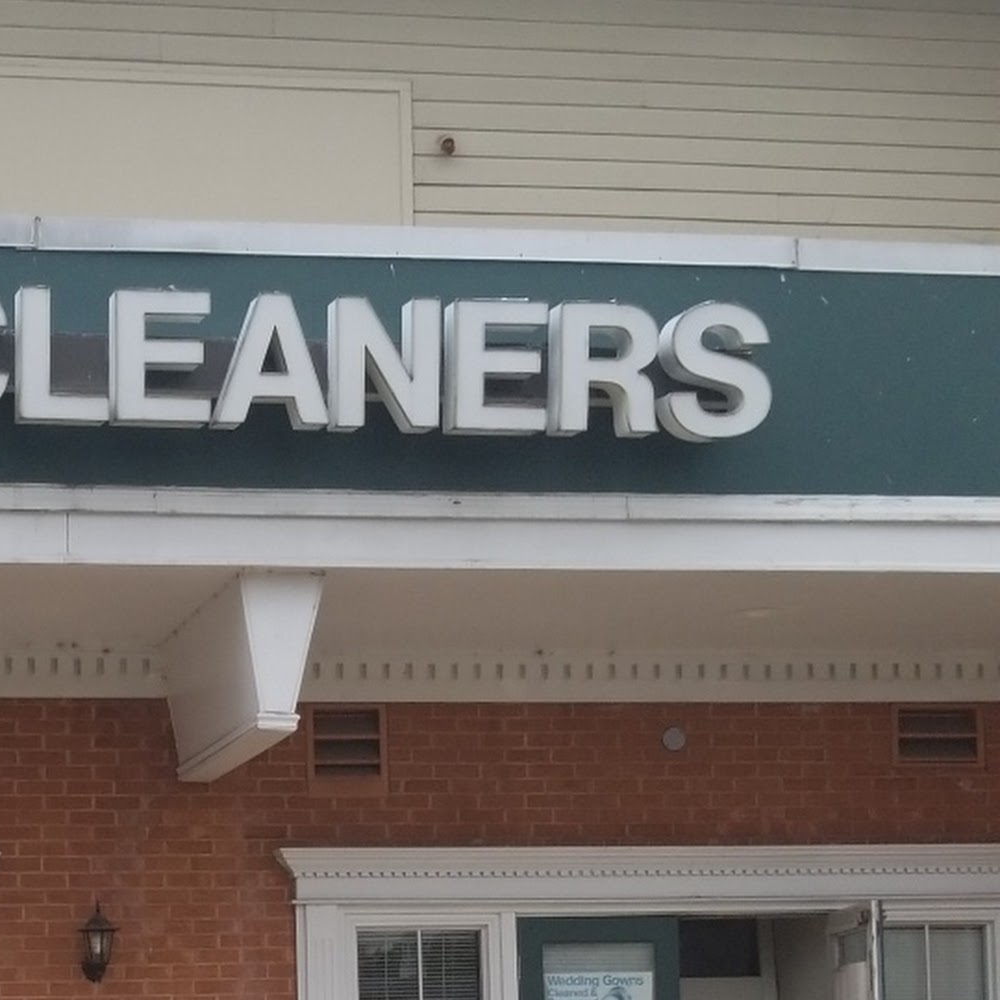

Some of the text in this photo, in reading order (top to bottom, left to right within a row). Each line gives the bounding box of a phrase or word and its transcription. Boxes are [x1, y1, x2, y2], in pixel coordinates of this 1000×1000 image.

[547, 974, 644, 988] Wedding Gowns
[547, 987, 589, 998] Cleaned
